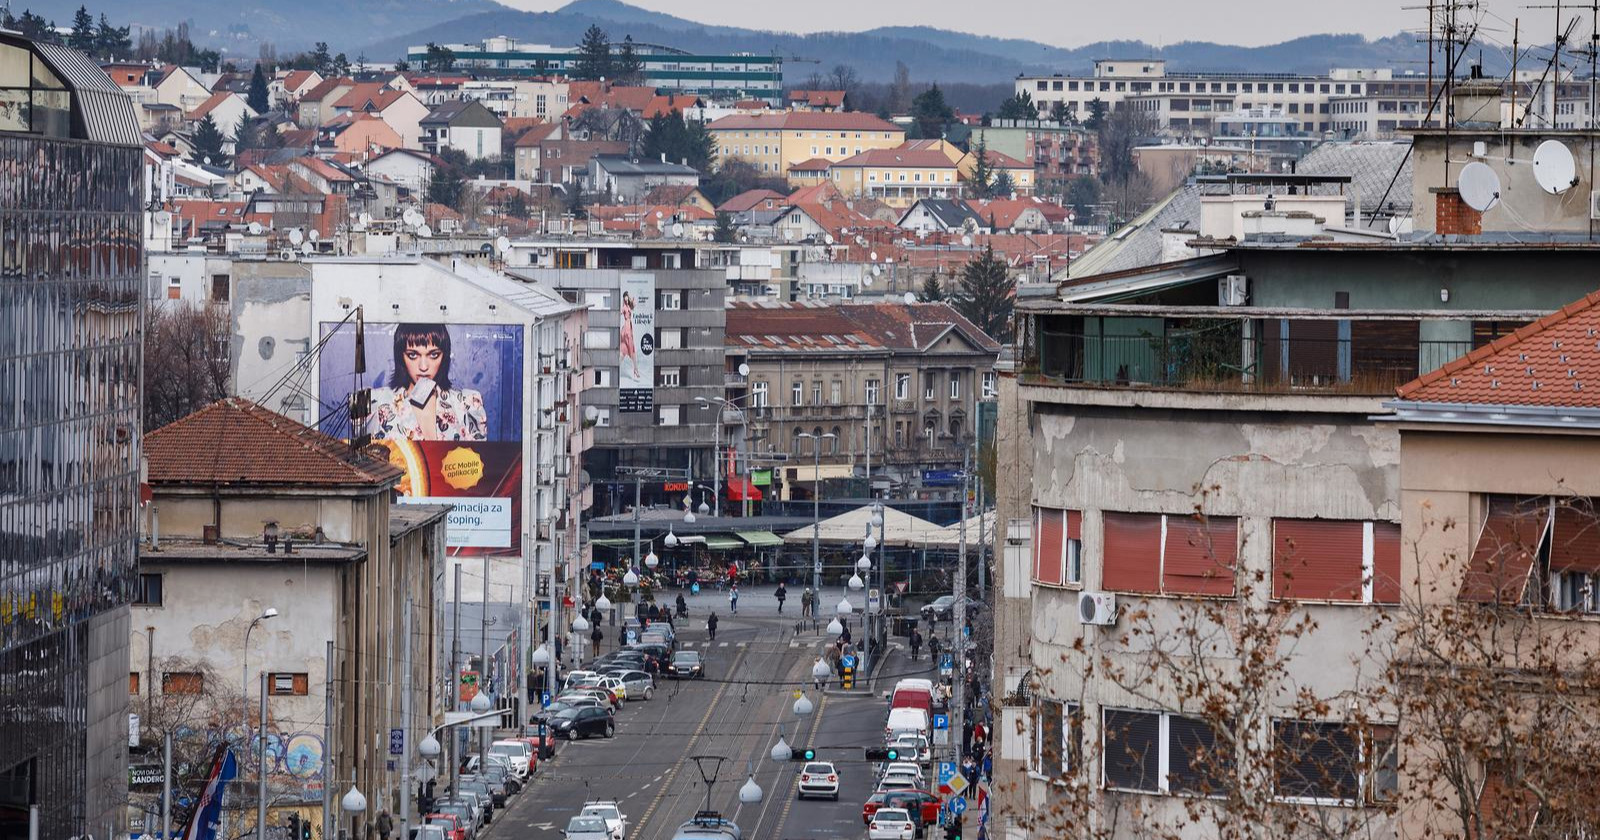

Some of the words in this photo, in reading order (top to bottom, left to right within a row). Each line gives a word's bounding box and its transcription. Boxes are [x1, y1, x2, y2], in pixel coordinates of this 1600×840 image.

[444, 463, 457, 471] ECC
[457, 460, 479, 469] Mobile
[447, 468, 479, 478] aplikacija
[447, 515, 483, 526] šoping.
[543, 695, 549, 705] P
[937, 717, 945, 727] P
[941, 762, 950, 774] P
[131, 775, 164, 784] SANDERO
